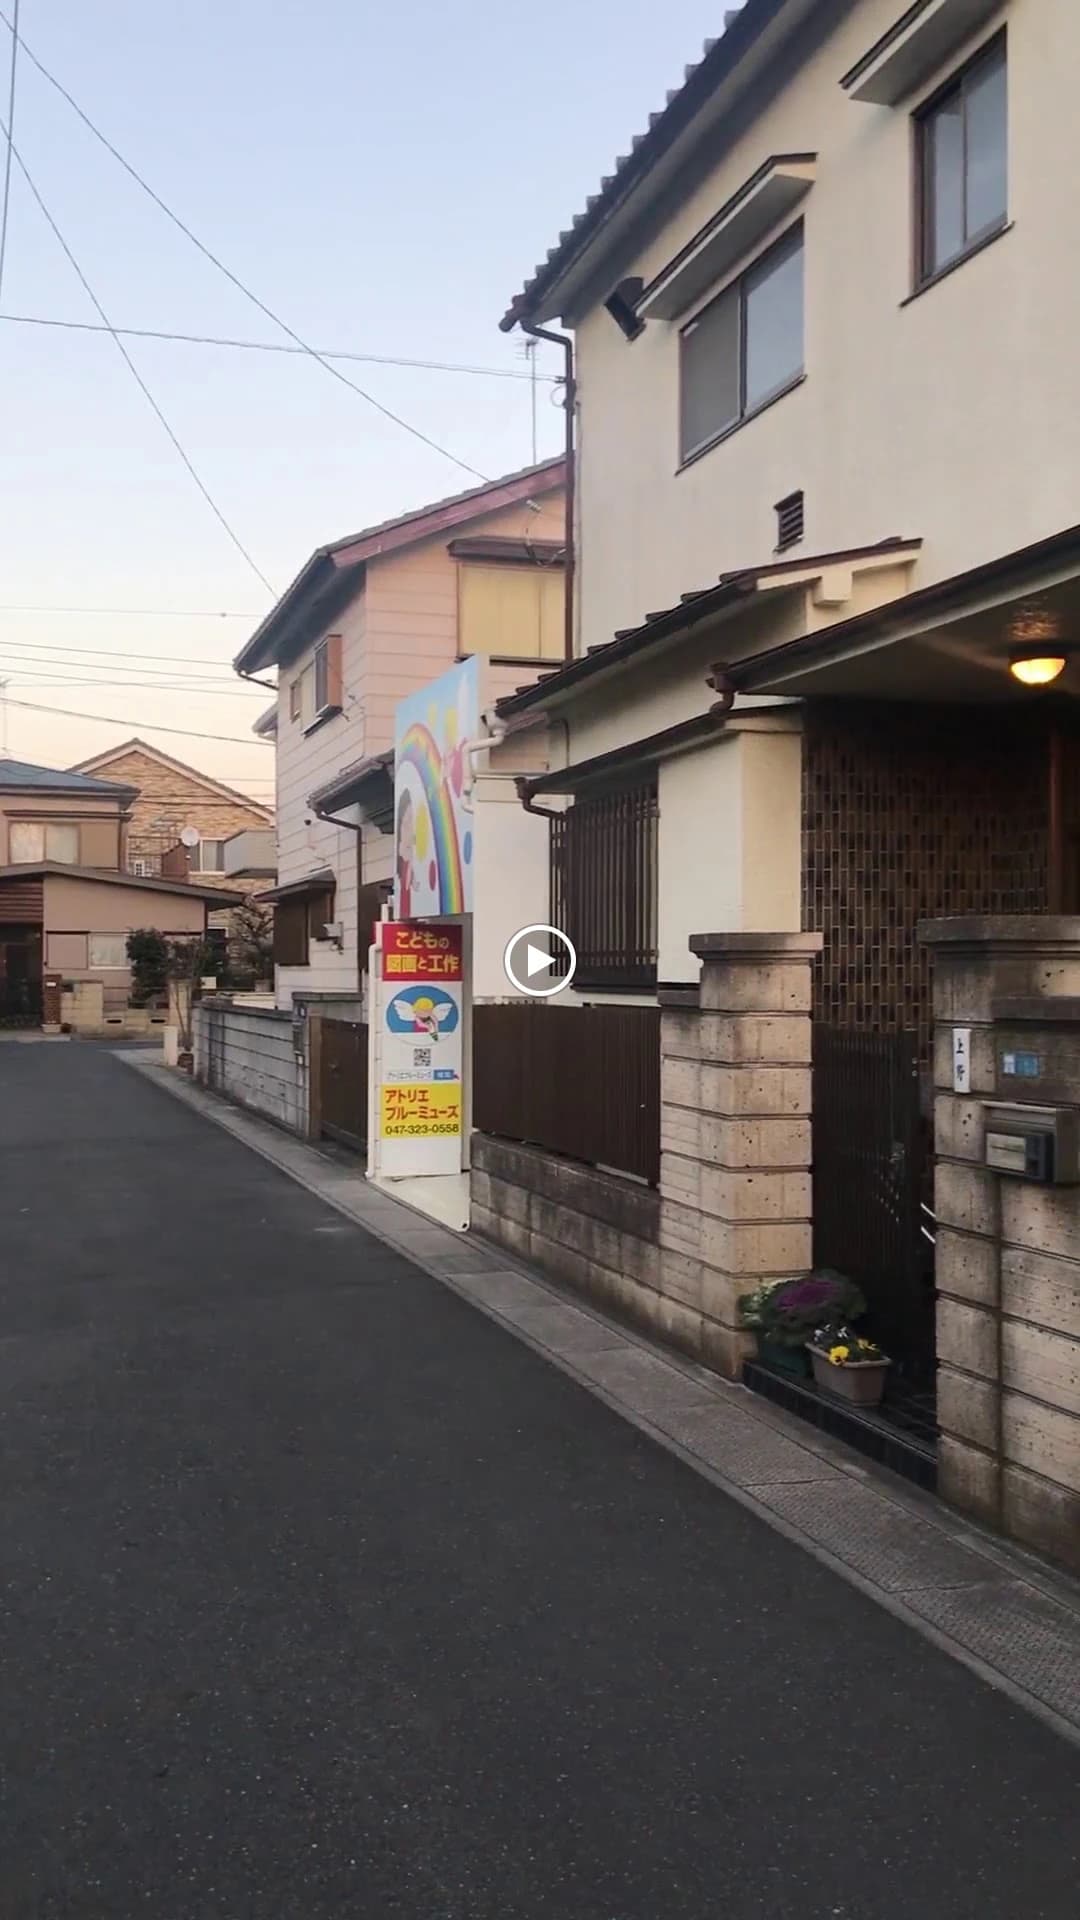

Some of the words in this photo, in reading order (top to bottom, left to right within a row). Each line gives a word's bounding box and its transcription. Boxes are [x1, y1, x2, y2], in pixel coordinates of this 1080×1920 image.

[396, 931, 449, 949] こどもの
[385, 1089, 429, 1103] アトリエ
[385, 1123, 459, 1135] 047-323-0558
